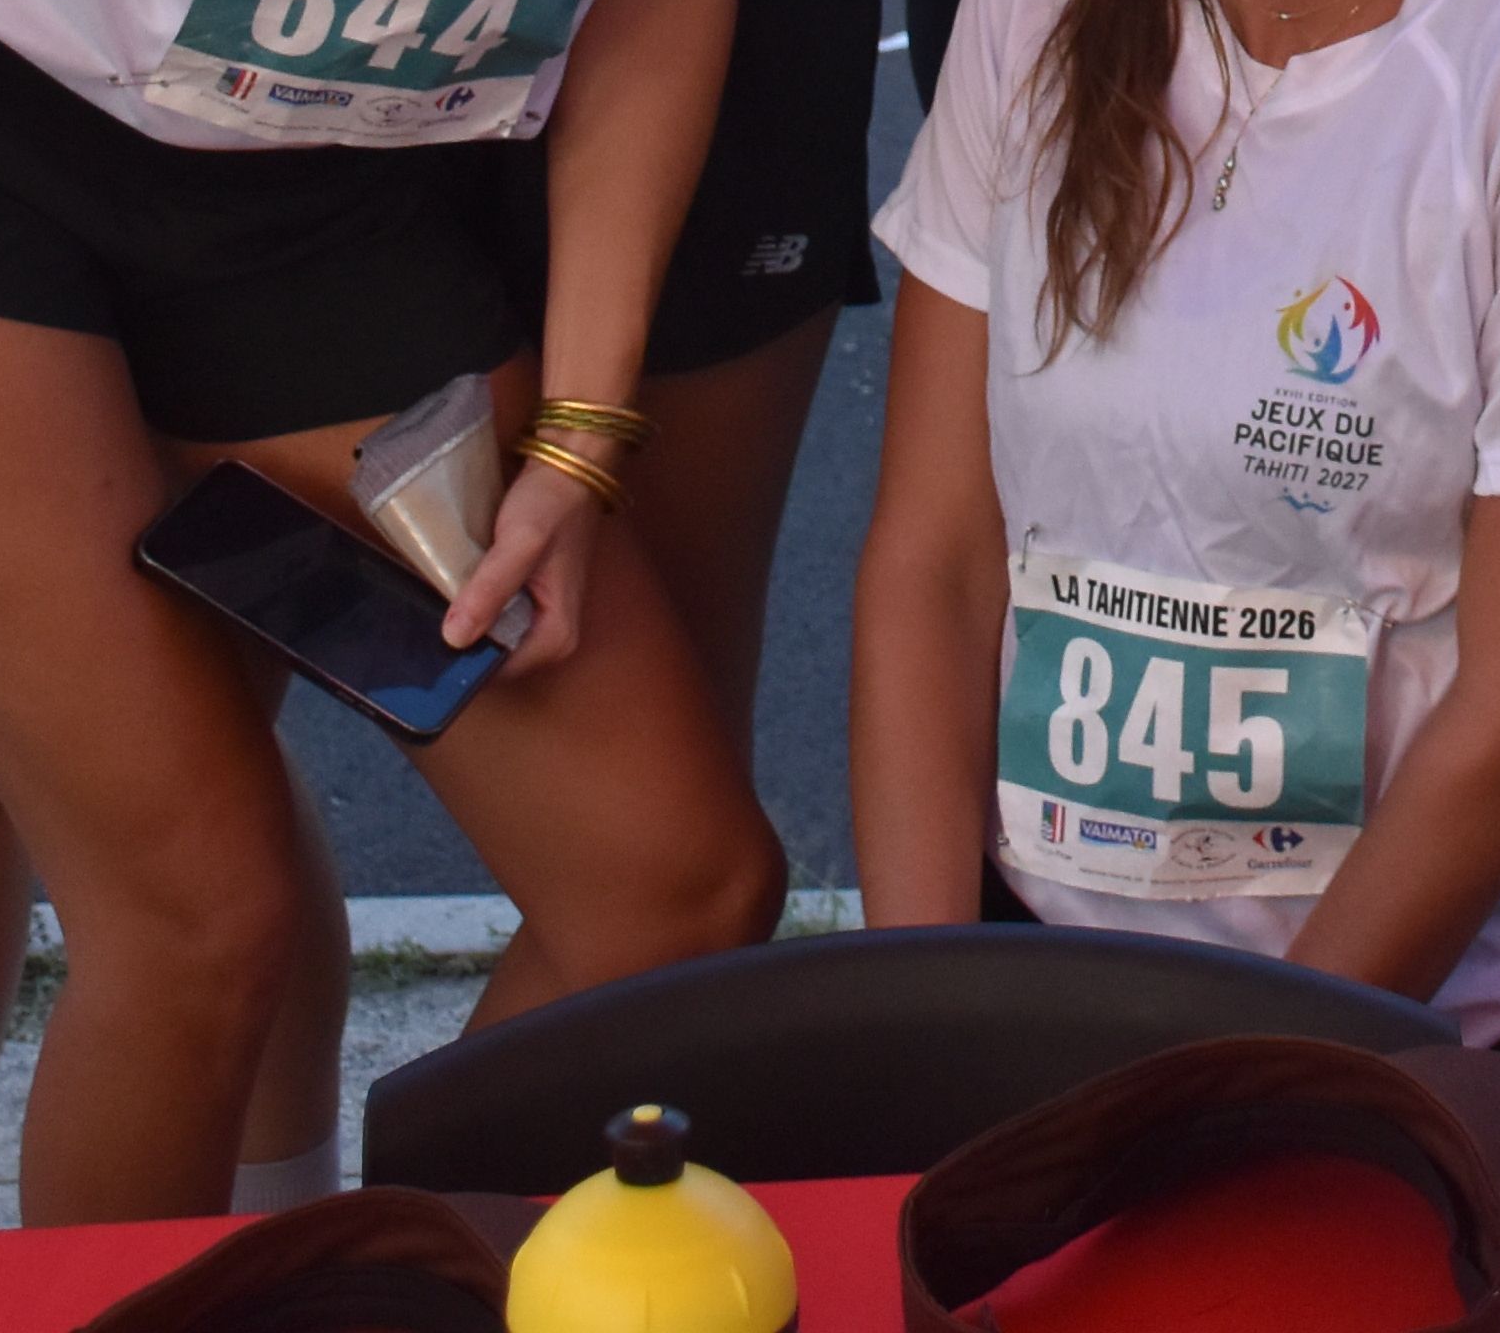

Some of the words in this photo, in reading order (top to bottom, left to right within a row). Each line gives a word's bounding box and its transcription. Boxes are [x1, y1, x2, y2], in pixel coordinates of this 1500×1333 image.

[1251, 399, 1325, 433] JEUX
[1335, 412, 1376, 439] DU
[1234, 422, 1384, 467] PACIFIQUE
[1243, 454, 1309, 484] TAHITI
[1317, 467, 1370, 492] 2027
[1051, 573, 1080, 604] LA
[1086, 578, 1228, 638] TAHITIENNE
[1239, 606, 1316, 640] 2026
[1048, 636, 1289, 810] 845
[1081, 822, 1156, 844] VAIMATO
